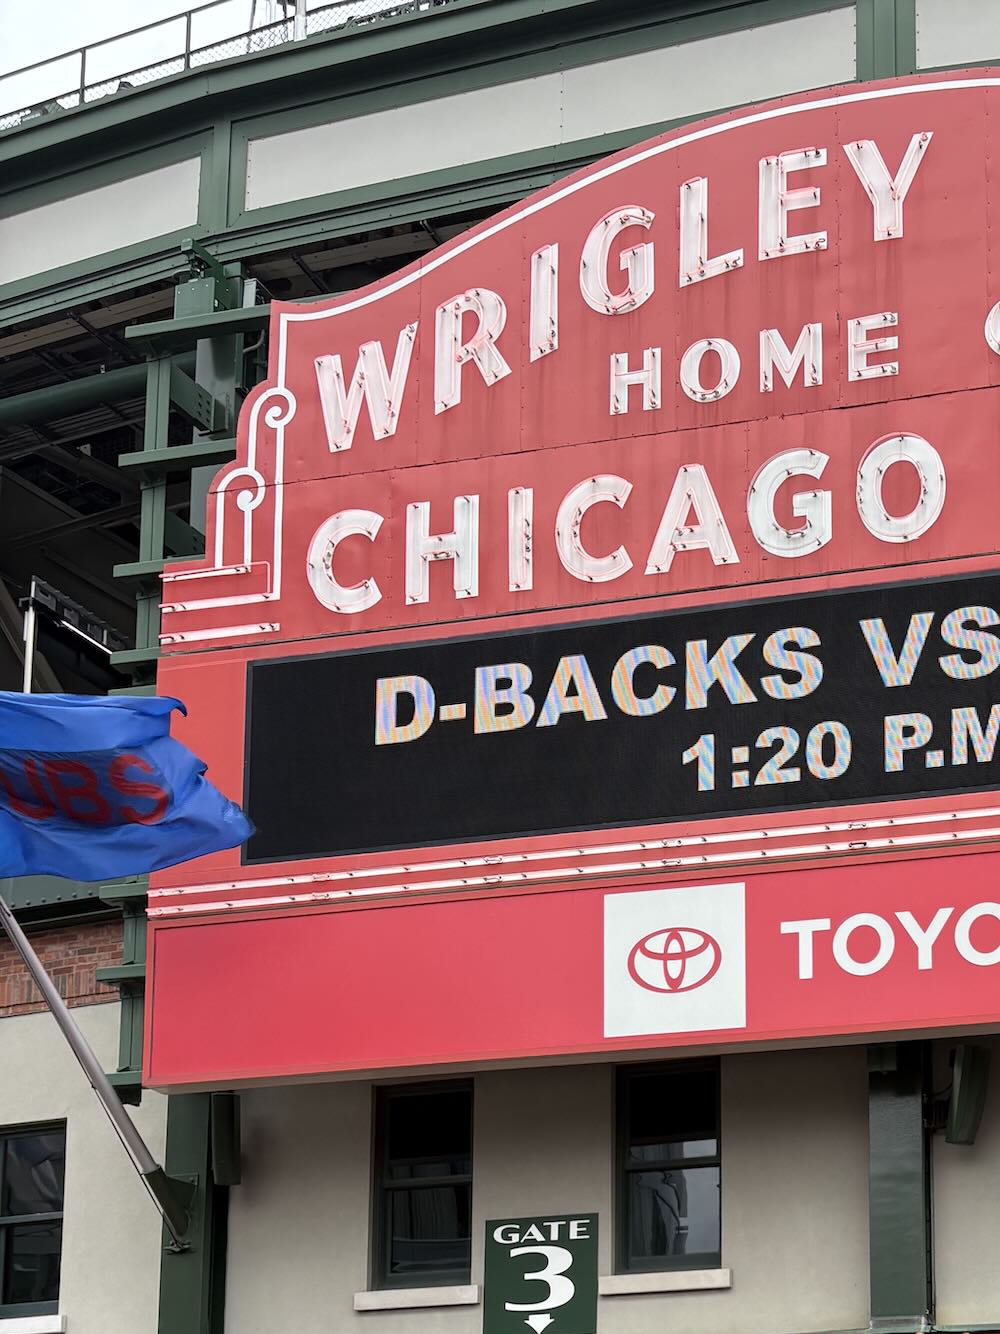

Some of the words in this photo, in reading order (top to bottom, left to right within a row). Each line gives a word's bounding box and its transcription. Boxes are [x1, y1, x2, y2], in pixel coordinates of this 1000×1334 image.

[313, 131, 934, 453] WRIGLEY
[609, 311, 900, 416] HOME
[305, 432, 947, 614] CHICAGO
[373, 626, 824, 746] D-BACKS
[681, 719, 853, 793] 1:20
[493, 1219, 591, 1245] GATE
[504, 1245, 576, 1313] 3
